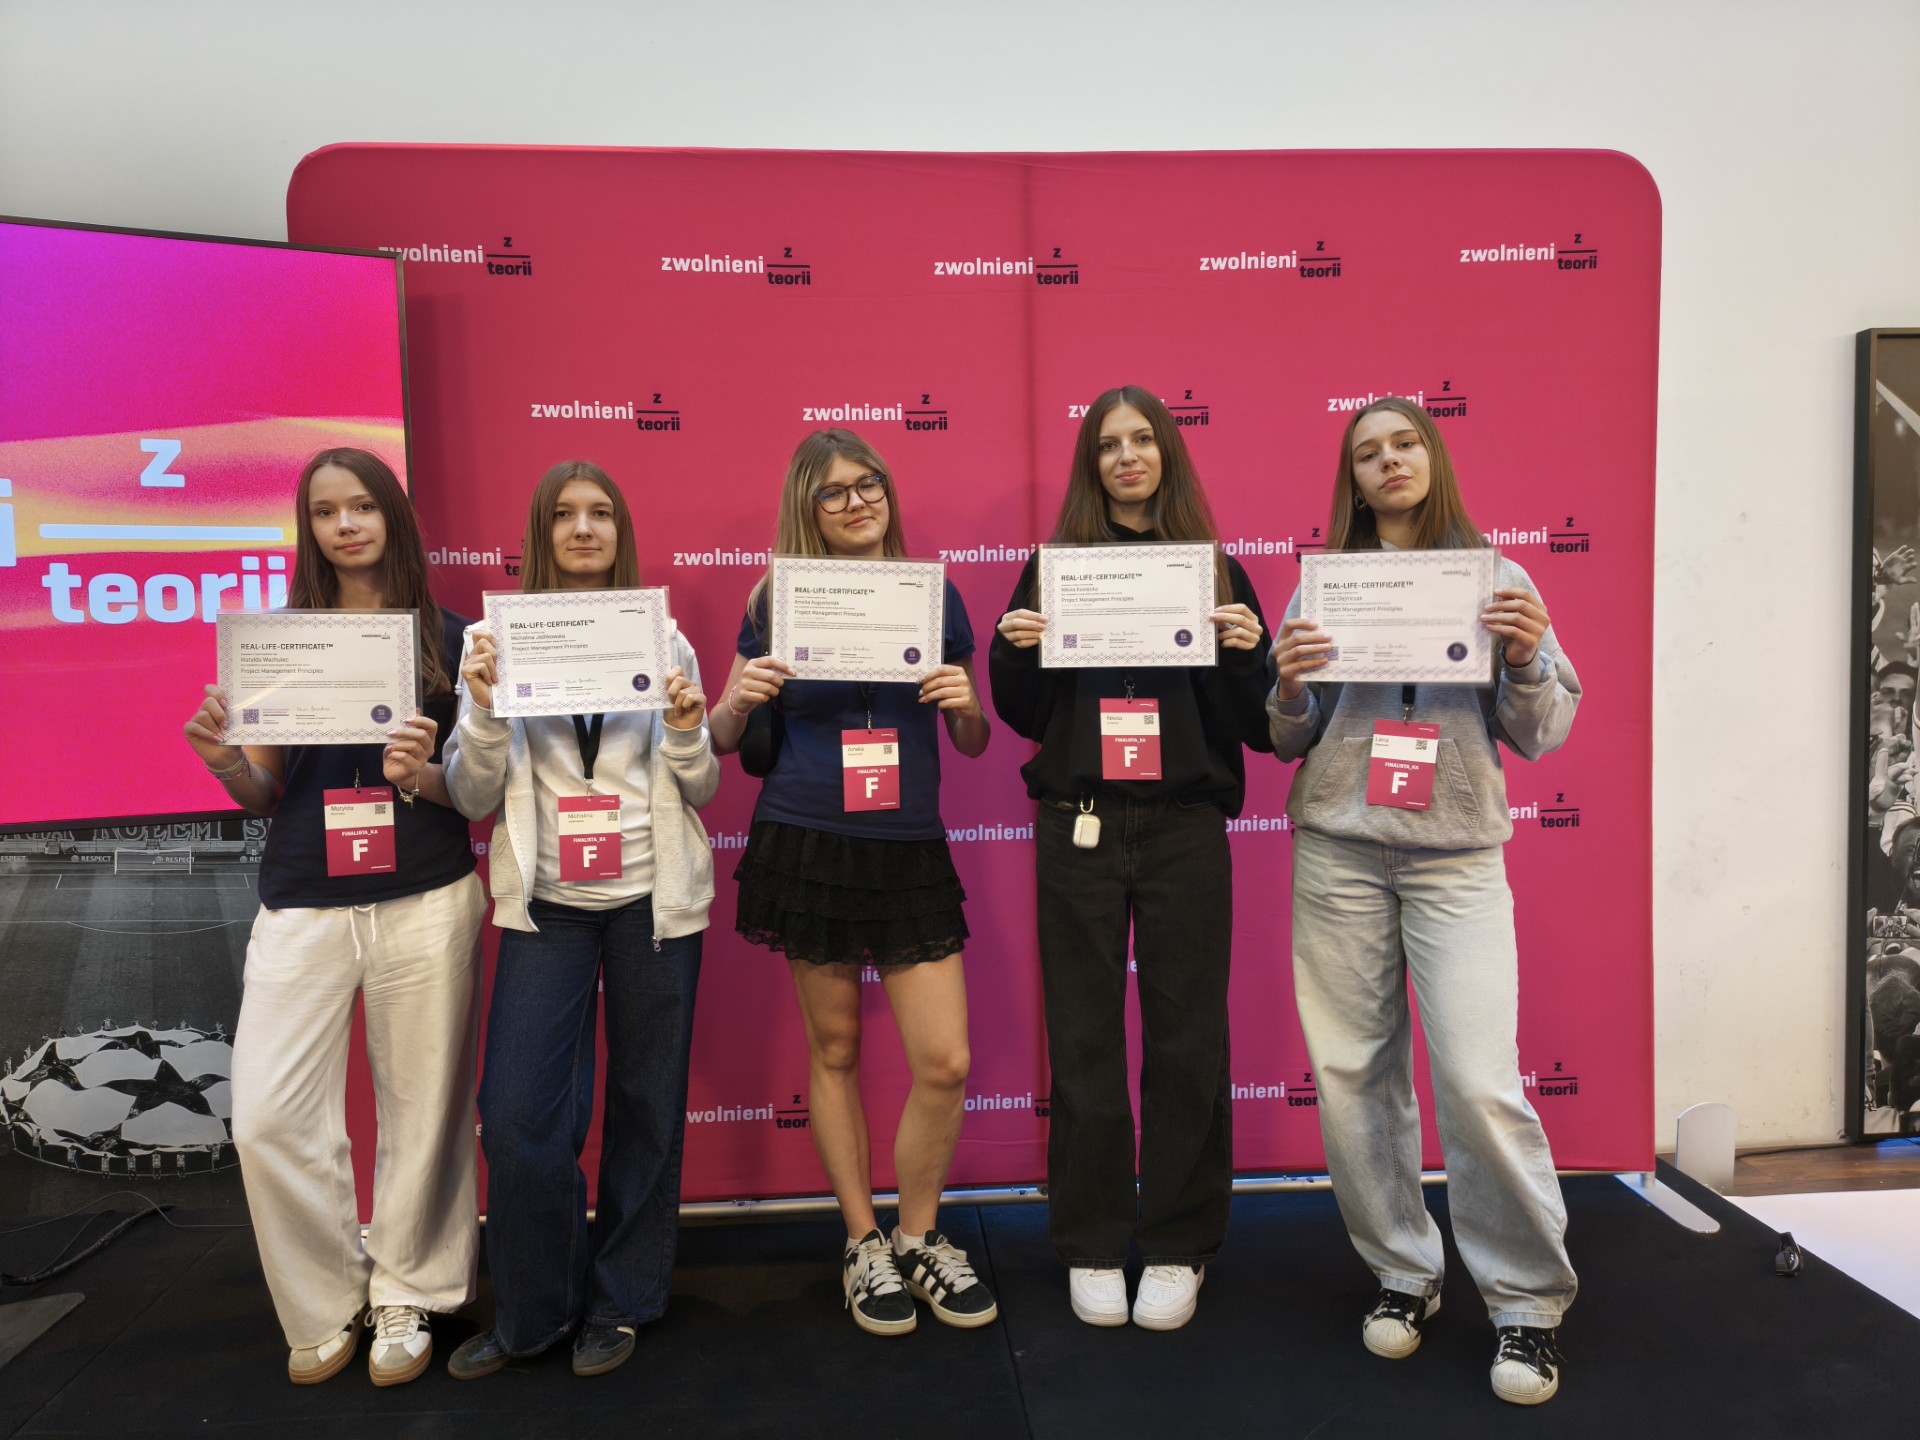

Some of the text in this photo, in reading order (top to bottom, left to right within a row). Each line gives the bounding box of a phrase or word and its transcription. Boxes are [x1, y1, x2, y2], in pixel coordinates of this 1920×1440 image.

[503, 236, 513, 248] z
[1316, 240, 1325, 252] z
[1573, 233, 1582, 245] z
[783, 247, 793, 259] z
[1053, 247, 1062, 259] z
[1459, 242, 1555, 263] zwolnieni
[661, 253, 764, 274] zwolnieni
[934, 256, 1034, 276] zwolnieni
[1199, 250, 1297, 271] zwolnieni
[1557, 255, 1598, 270] teorii
[486, 261, 532, 276] teorii
[1299, 262, 1341, 278] teorii
[767, 271, 811, 286] teorii
[1036, 270, 1079, 285] teorii
[1442, 380, 1451, 392] z
[652, 393, 662, 404] z
[921, 394, 931, 405] z
[1184, 389, 1193, 400] z
[531, 400, 634, 420] zwolnieni
[802, 402, 903, 422] zwolnieni
[636, 416, 681, 431] teorii
[905, 416, 948, 431] teorii
[1174, 411, 1209, 427] eorii
[140, 438, 186, 488] z
[1565, 517, 1574, 528] z
[1311, 527, 1320, 538] z
[1549, 537, 1590, 554] teorii
[427, 547, 501, 566] olnieni
[41, 556, 287, 624] teorii
[1124, 746, 1138, 768] F
[865, 776, 878, 798] F
[1392, 771, 1408, 794] F
[1556, 792, 1564, 803] z
[1540, 814, 1580, 829] teorii
[947, 822, 1034, 842] wolnieni
[352, 838, 368, 862] F
[582, 845, 598, 868] F
[1554, 1062, 1563, 1072] z
[1303, 1072, 1312, 1083] z
[1231, 1081, 1285, 1100] lnieni
[1538, 1080, 1578, 1096] teorii
[792, 1094, 801, 1105] z
[963, 1092, 1032, 1111] olnieni
[686, 1103, 773, 1124] wolnieni
